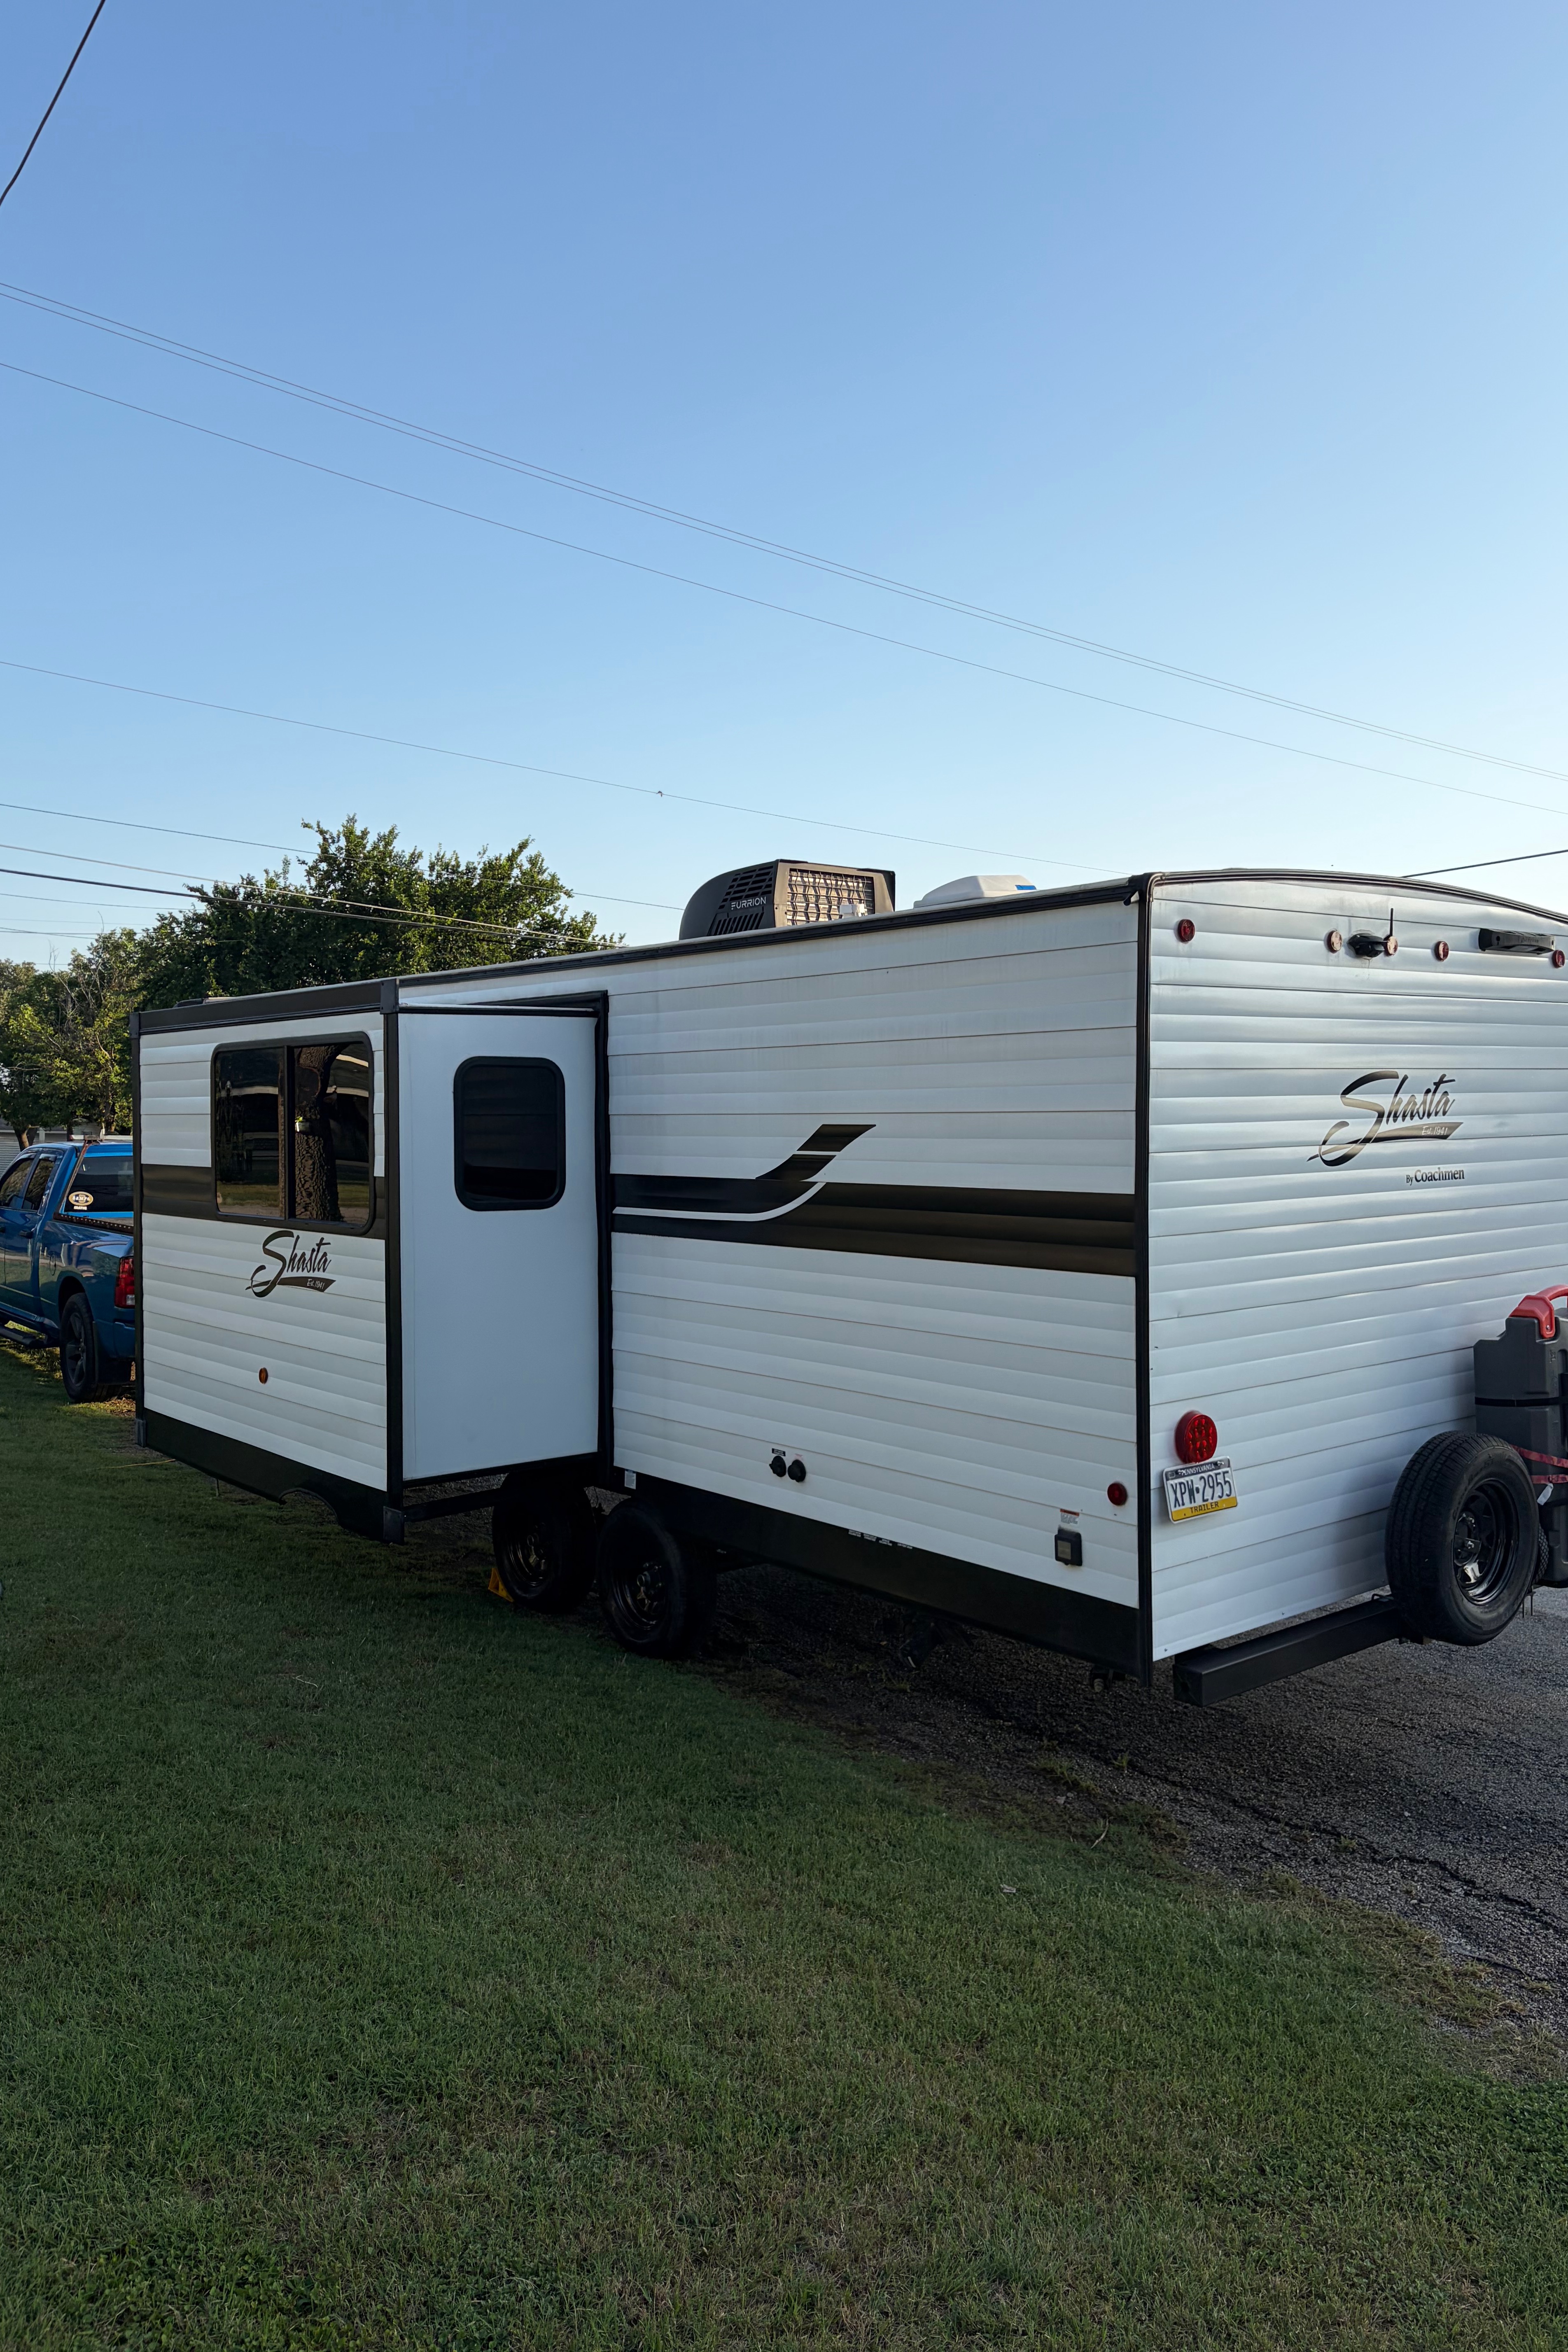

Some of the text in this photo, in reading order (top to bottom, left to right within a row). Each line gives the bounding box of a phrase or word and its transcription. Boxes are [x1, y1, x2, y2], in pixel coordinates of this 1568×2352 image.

[731, 896, 766, 910] FURRION
[1318, 1070, 1456, 1166] Shasta
[1433, 1126, 1448, 1135] 1941
[1406, 1167, 1465, 1186] By Coachmen
[250, 1230, 331, 1297] Shasta
[1181, 1463, 1215, 1476] PENNSYLVANIA
[1190, 1501, 1219, 1513] TRAILER
